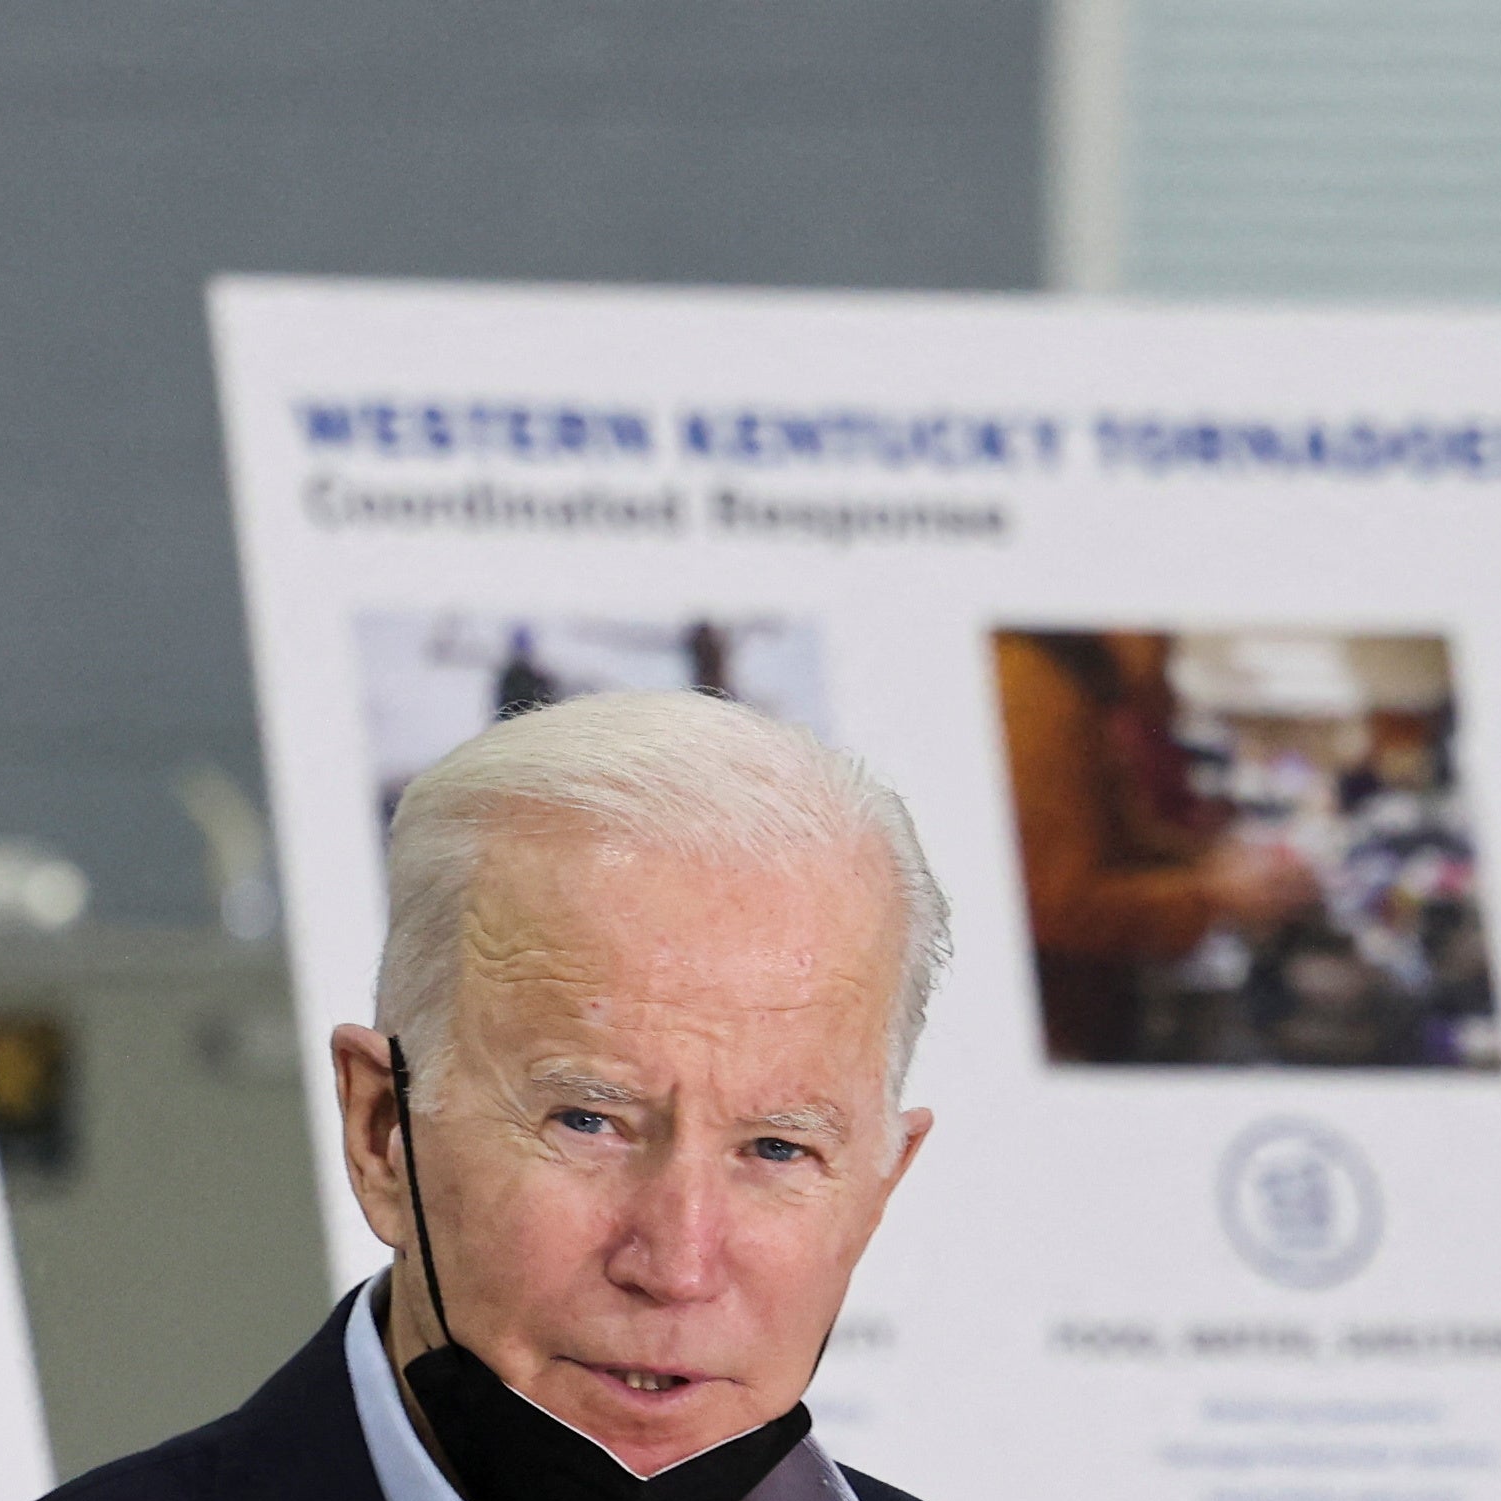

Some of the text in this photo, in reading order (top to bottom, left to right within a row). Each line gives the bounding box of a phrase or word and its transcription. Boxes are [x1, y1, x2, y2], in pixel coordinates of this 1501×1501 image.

[295, 400, 657, 460] WESTERN
[679, 406, 1067, 468] KENTUCKY
[303, 472, 1015, 542] Coordinated Response
